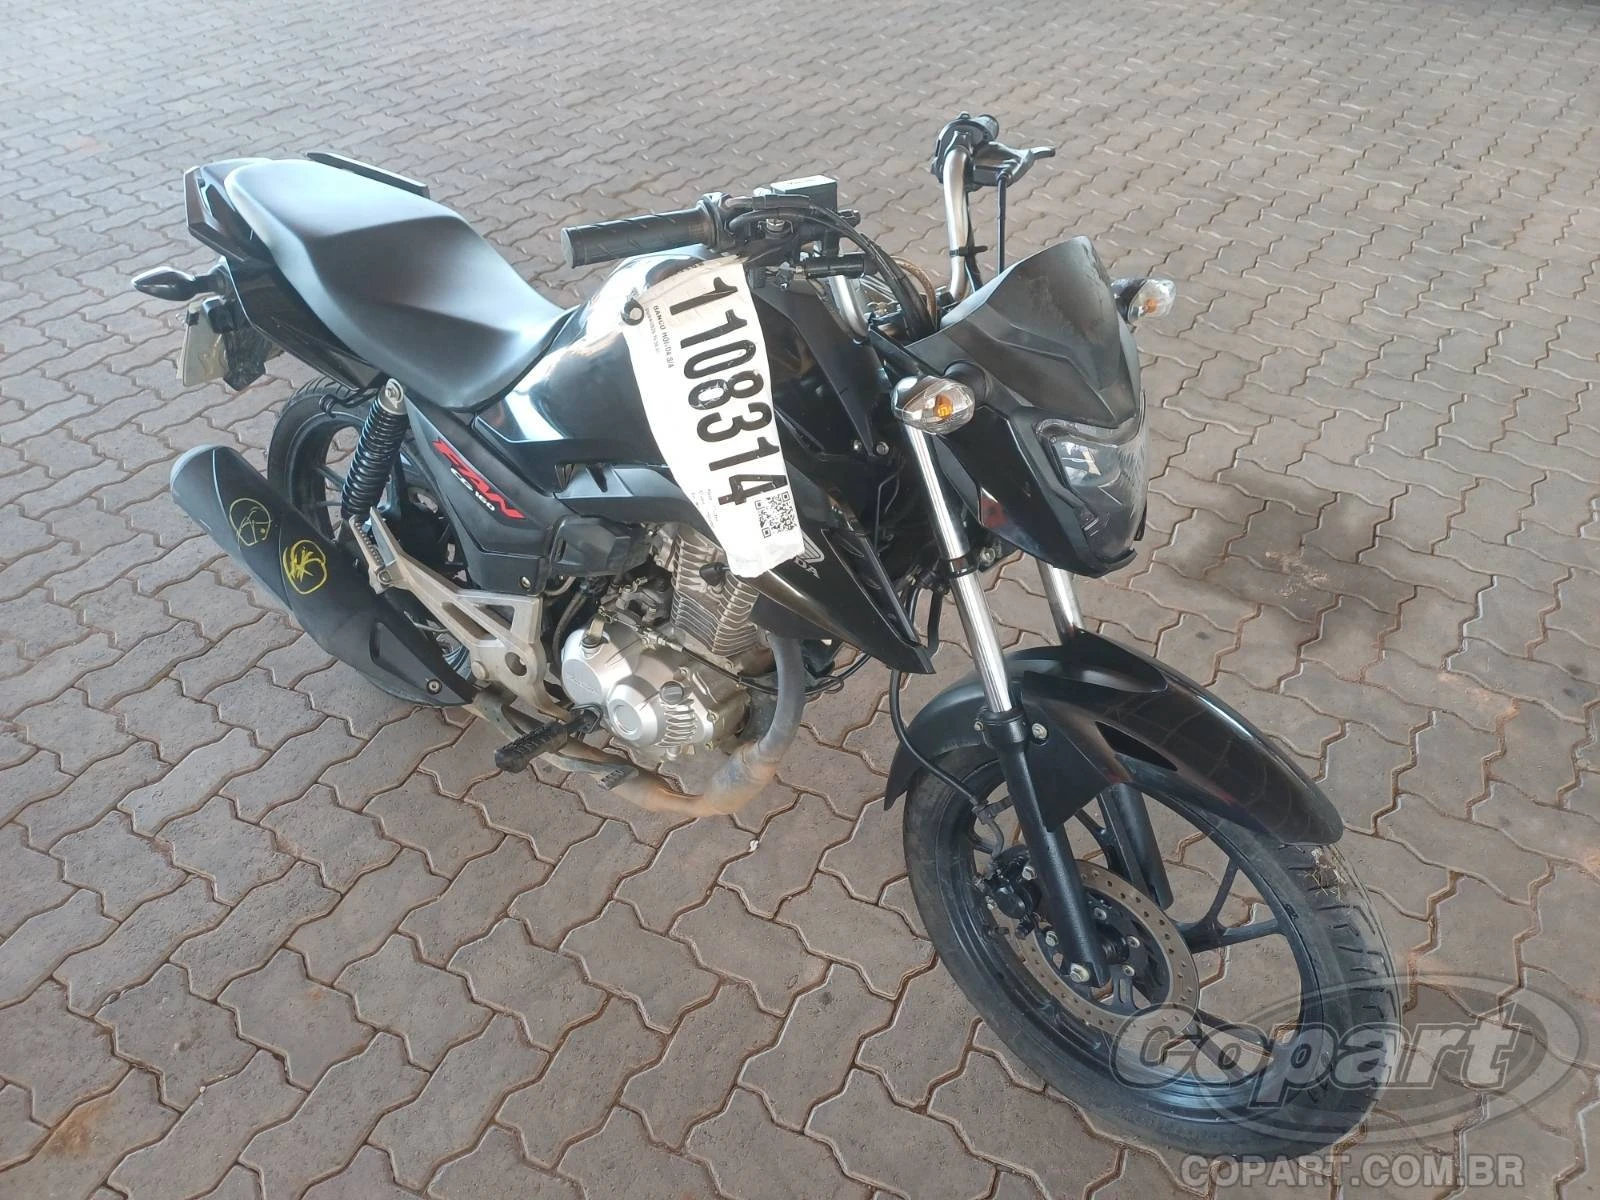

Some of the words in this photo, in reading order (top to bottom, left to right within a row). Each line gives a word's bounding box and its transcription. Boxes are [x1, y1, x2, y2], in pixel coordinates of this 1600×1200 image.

[653, 305, 666, 330] BANCO
[669, 276, 788, 506] 1108314
[475, 490, 496, 512] 160
